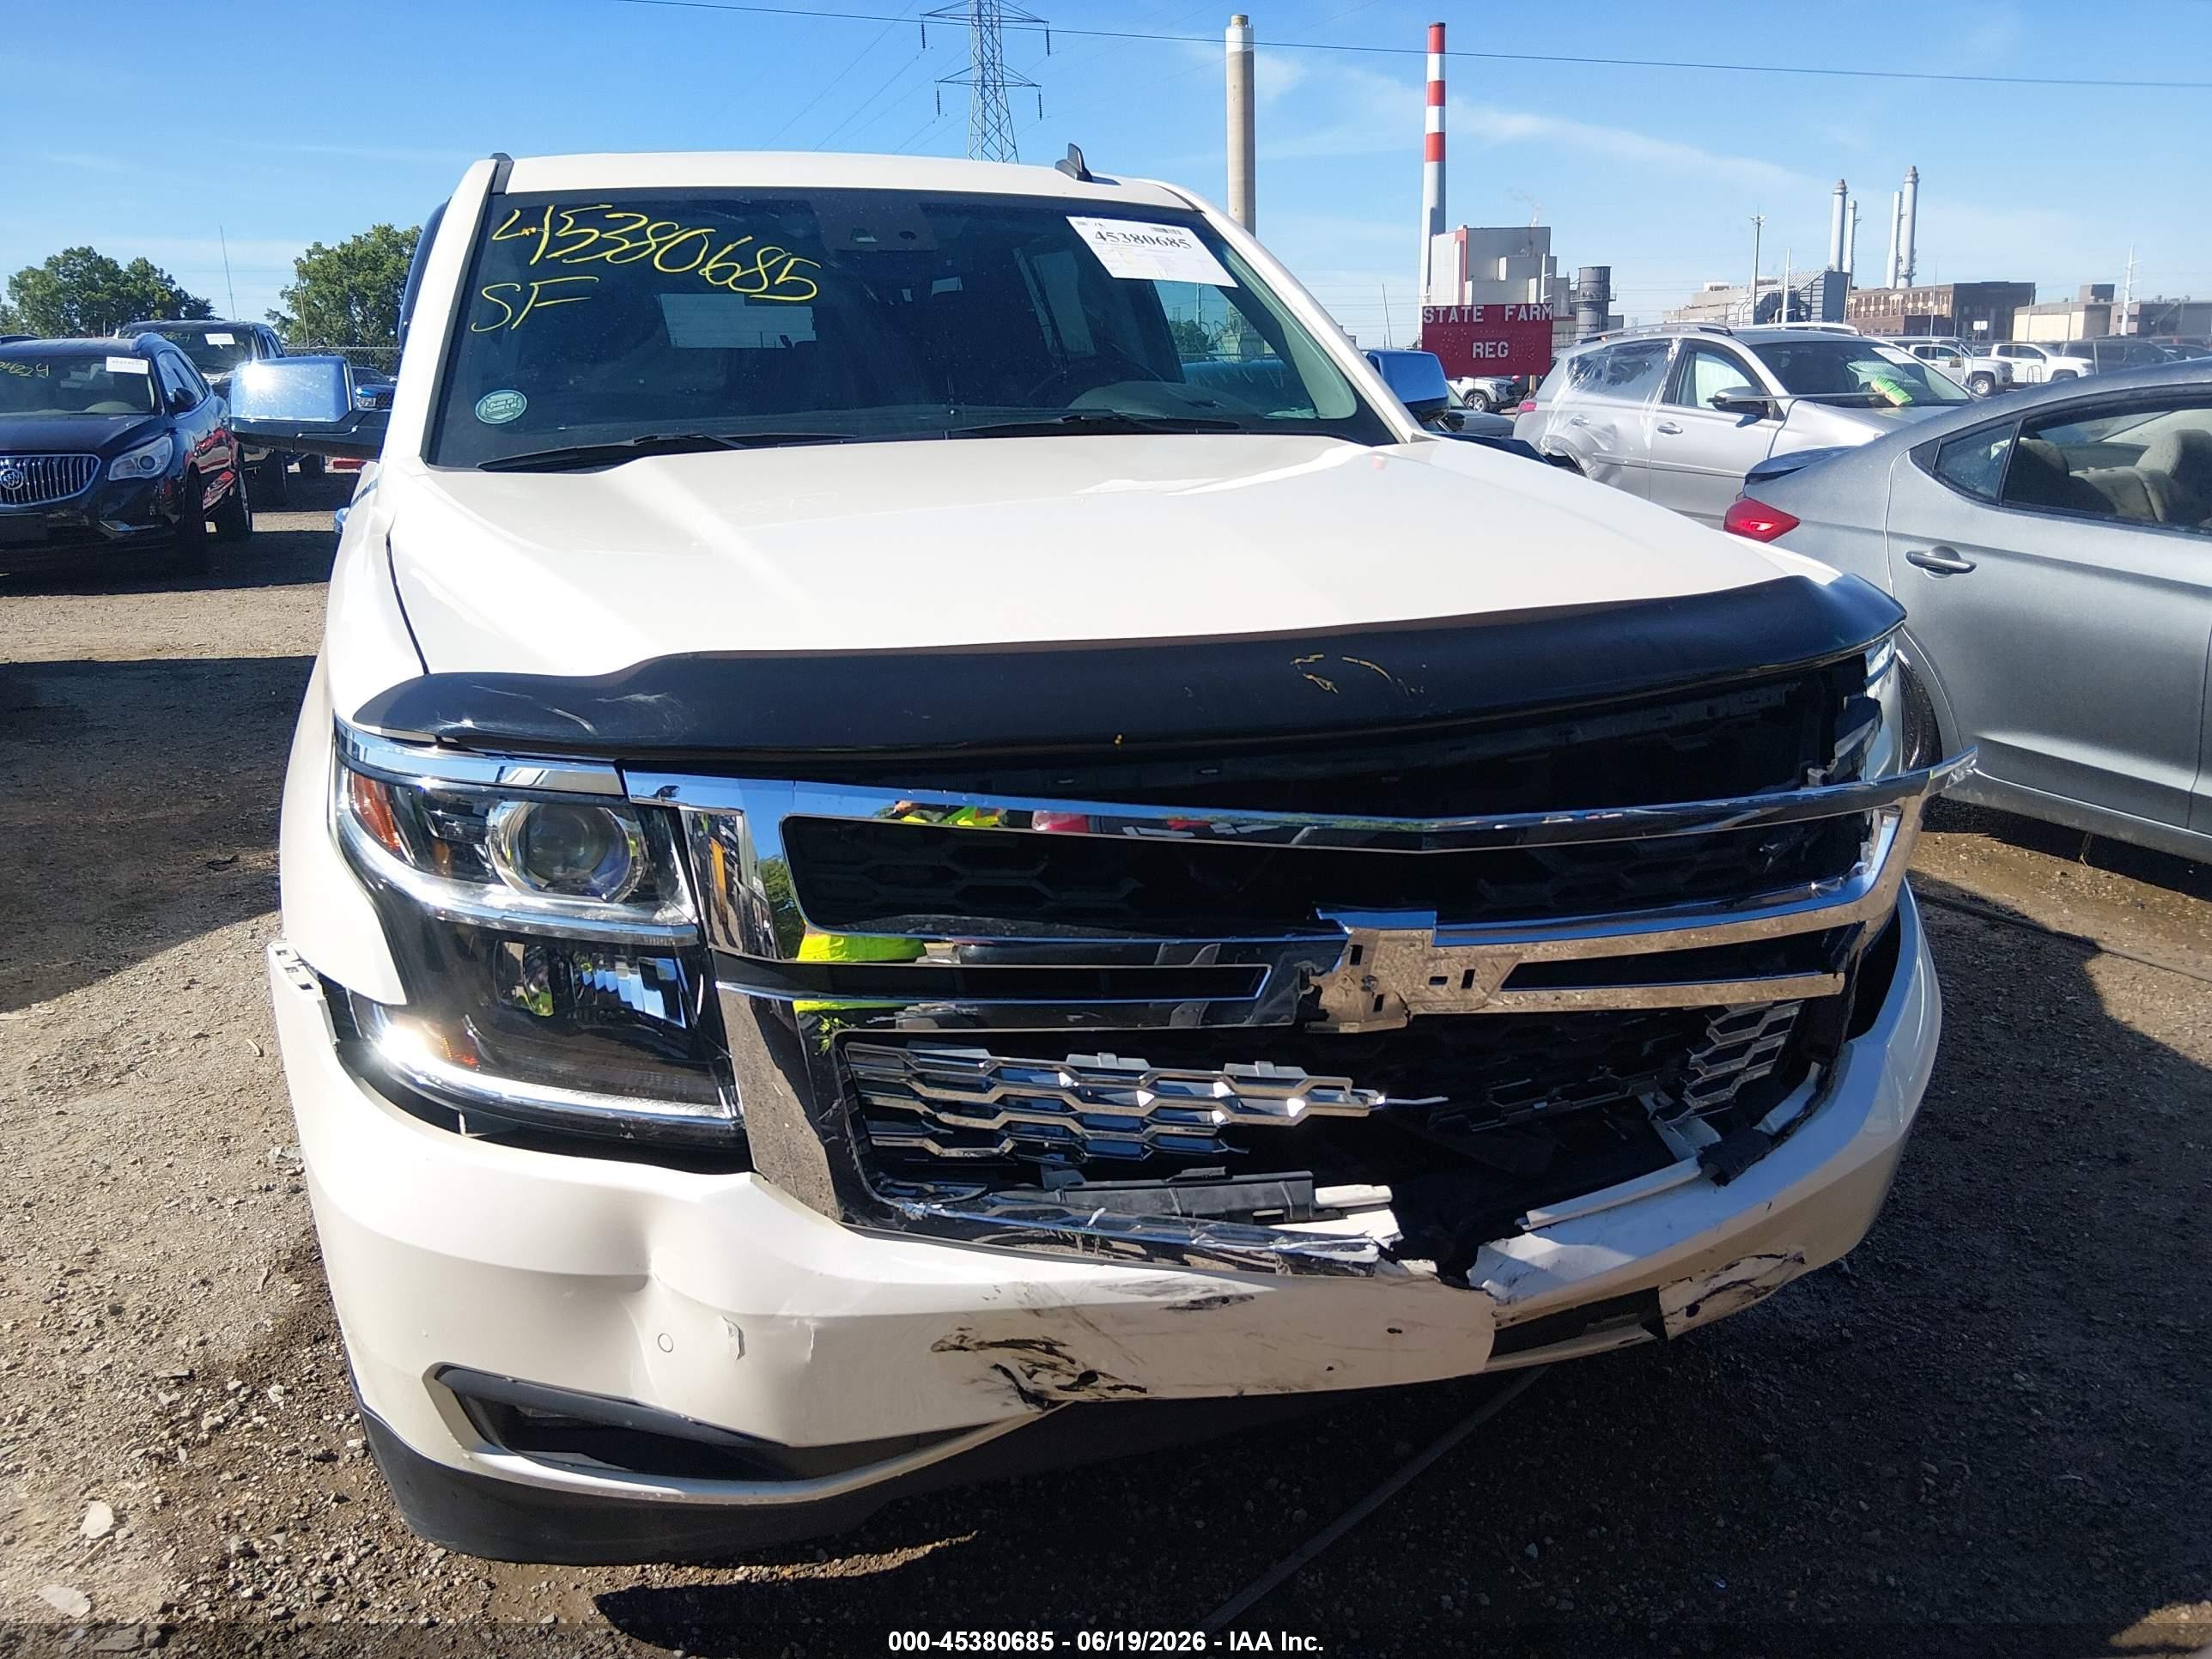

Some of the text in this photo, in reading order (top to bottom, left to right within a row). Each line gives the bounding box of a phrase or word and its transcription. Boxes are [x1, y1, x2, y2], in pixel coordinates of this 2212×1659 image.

[1095, 230, 1192, 250] 45380685
[492, 204, 821, 301] 45380685
[471, 276, 599, 332] SF
[1423, 304, 1553, 324] STATE FARM
[1472, 341, 1509, 359] REG
